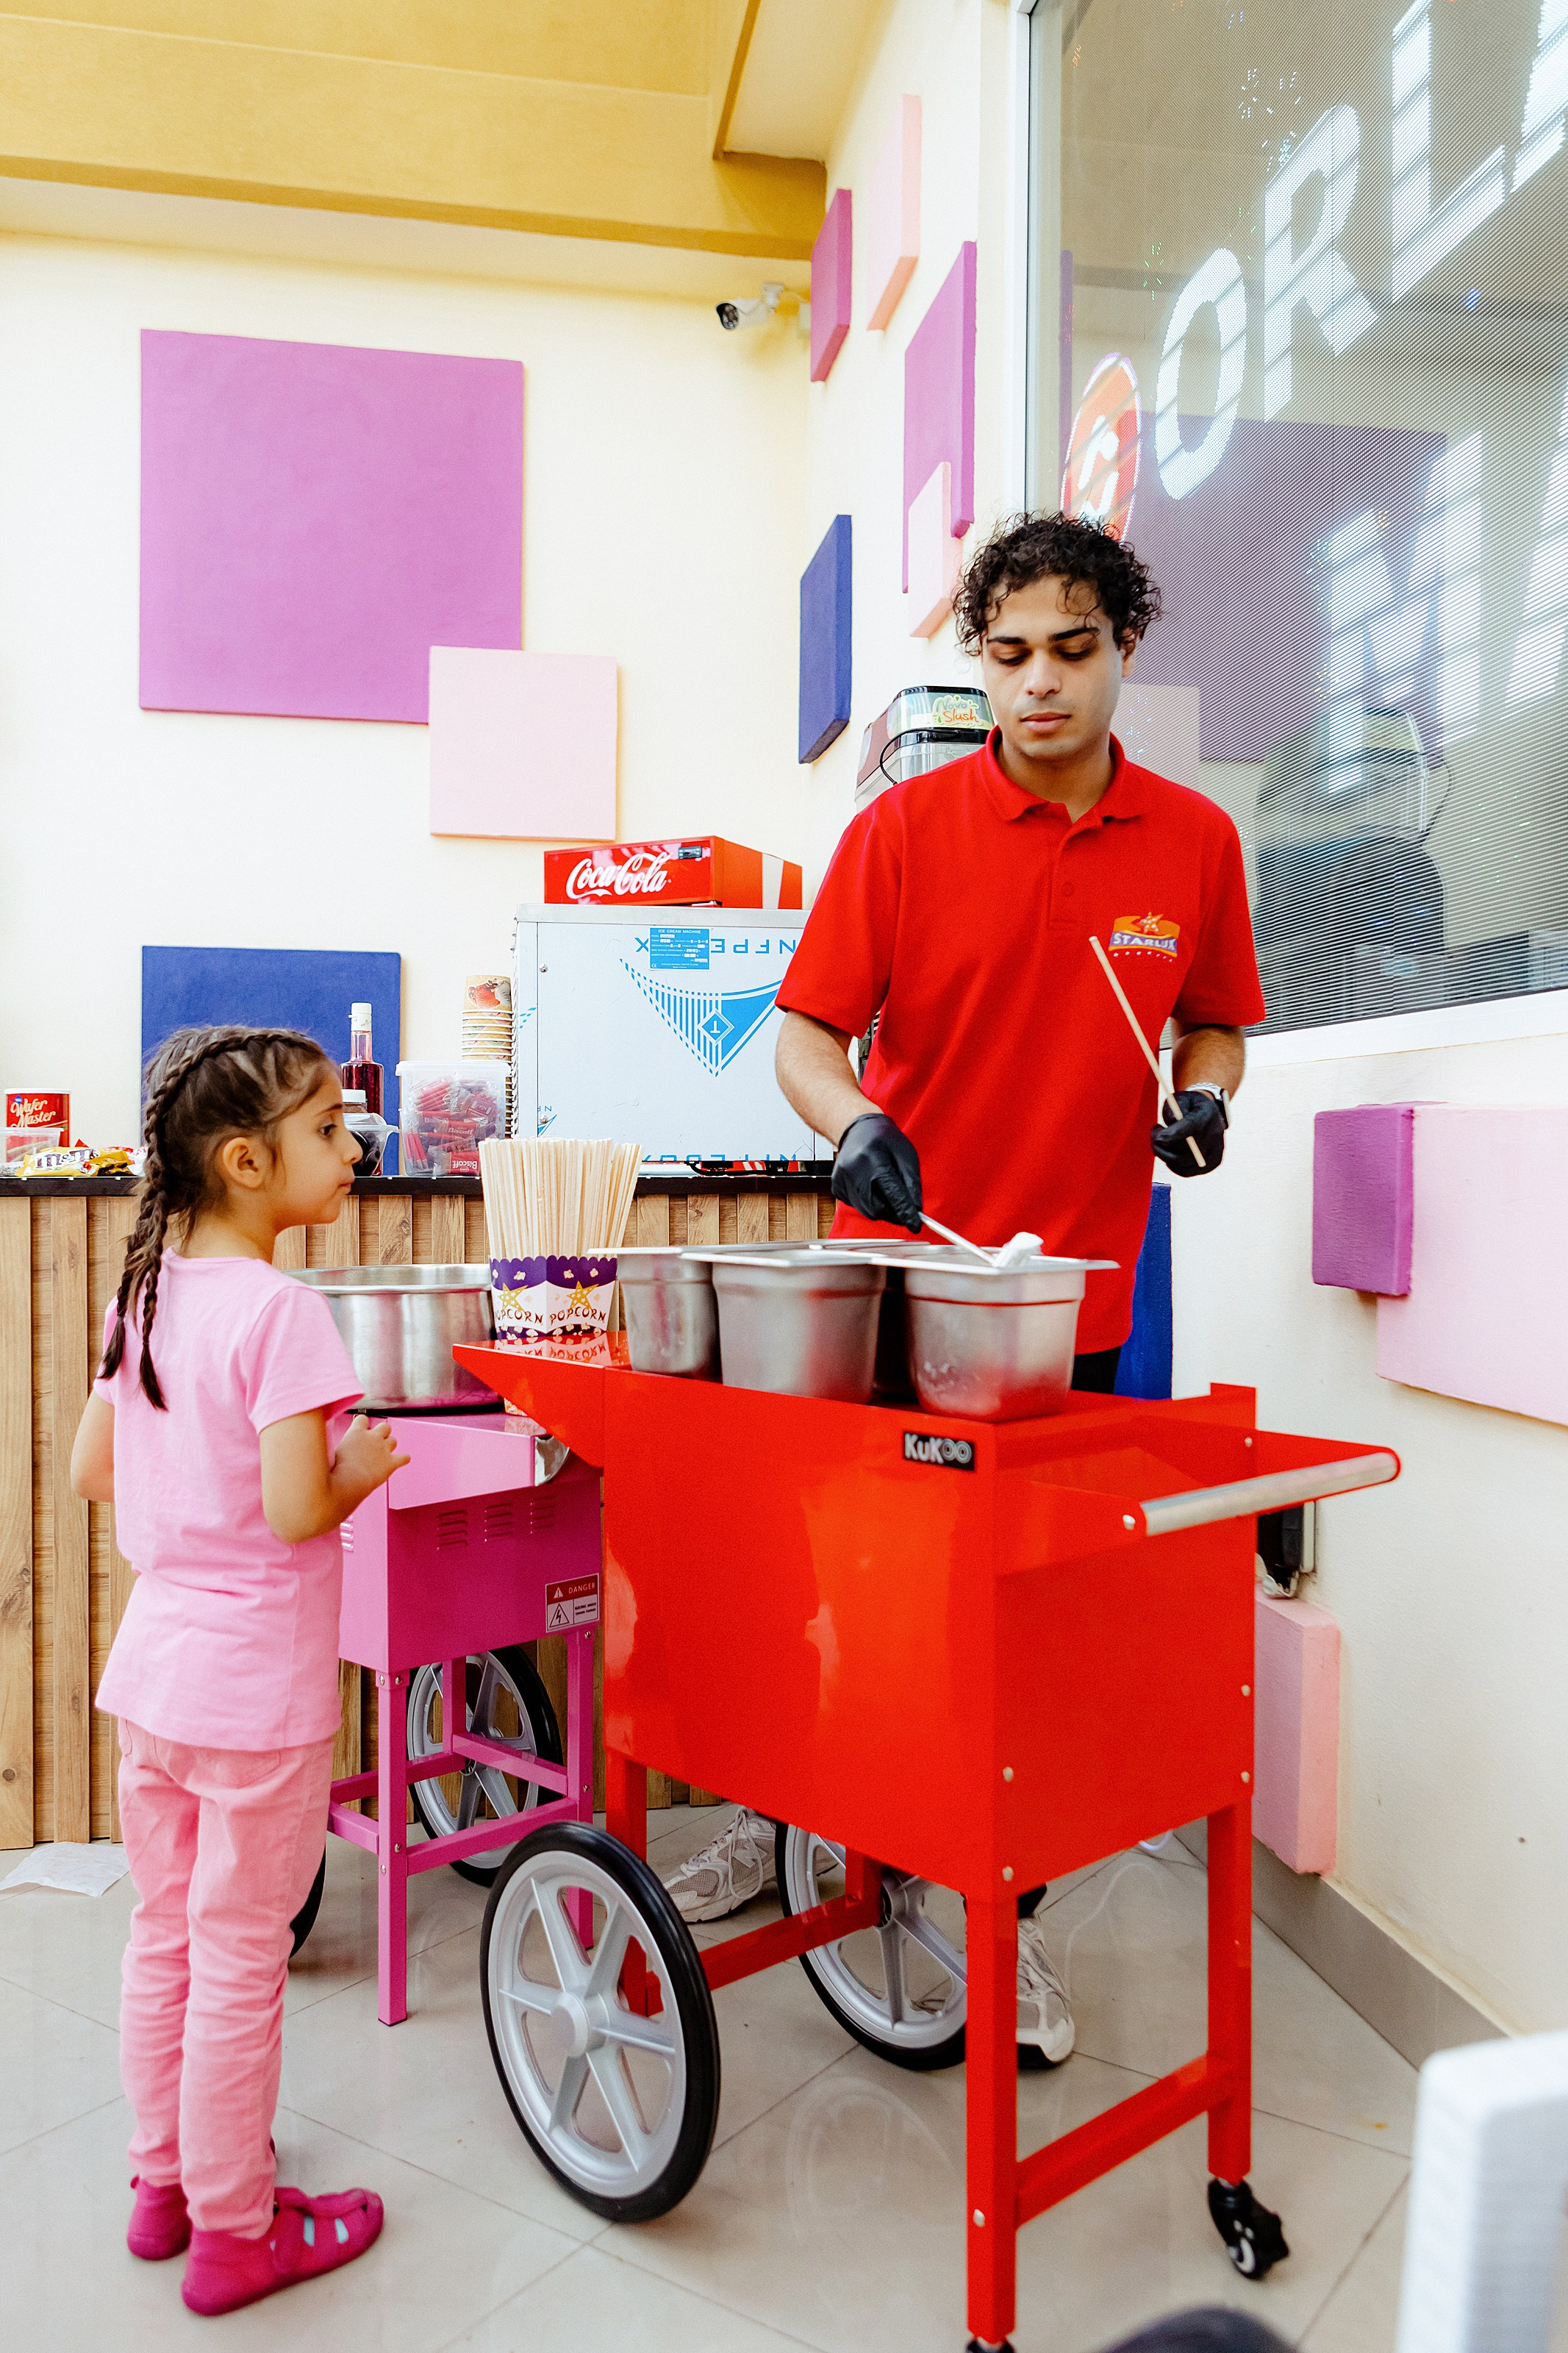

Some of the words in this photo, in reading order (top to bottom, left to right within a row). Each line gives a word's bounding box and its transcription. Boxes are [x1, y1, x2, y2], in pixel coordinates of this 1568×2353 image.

[936, 698, 967, 713] Novo
[943, 709, 979, 722] Slush
[566, 851, 672, 899] Coca-Cola
[1113, 932, 1176, 951] STARLUX
[10, 1098, 48, 1117] Wafer
[16, 1110, 56, 1129] Master
[452, 1160, 478, 1169] Biscoff
[549, 1306, 607, 1324] POPCORN
[568, 1582, 595, 1594] DANGER
